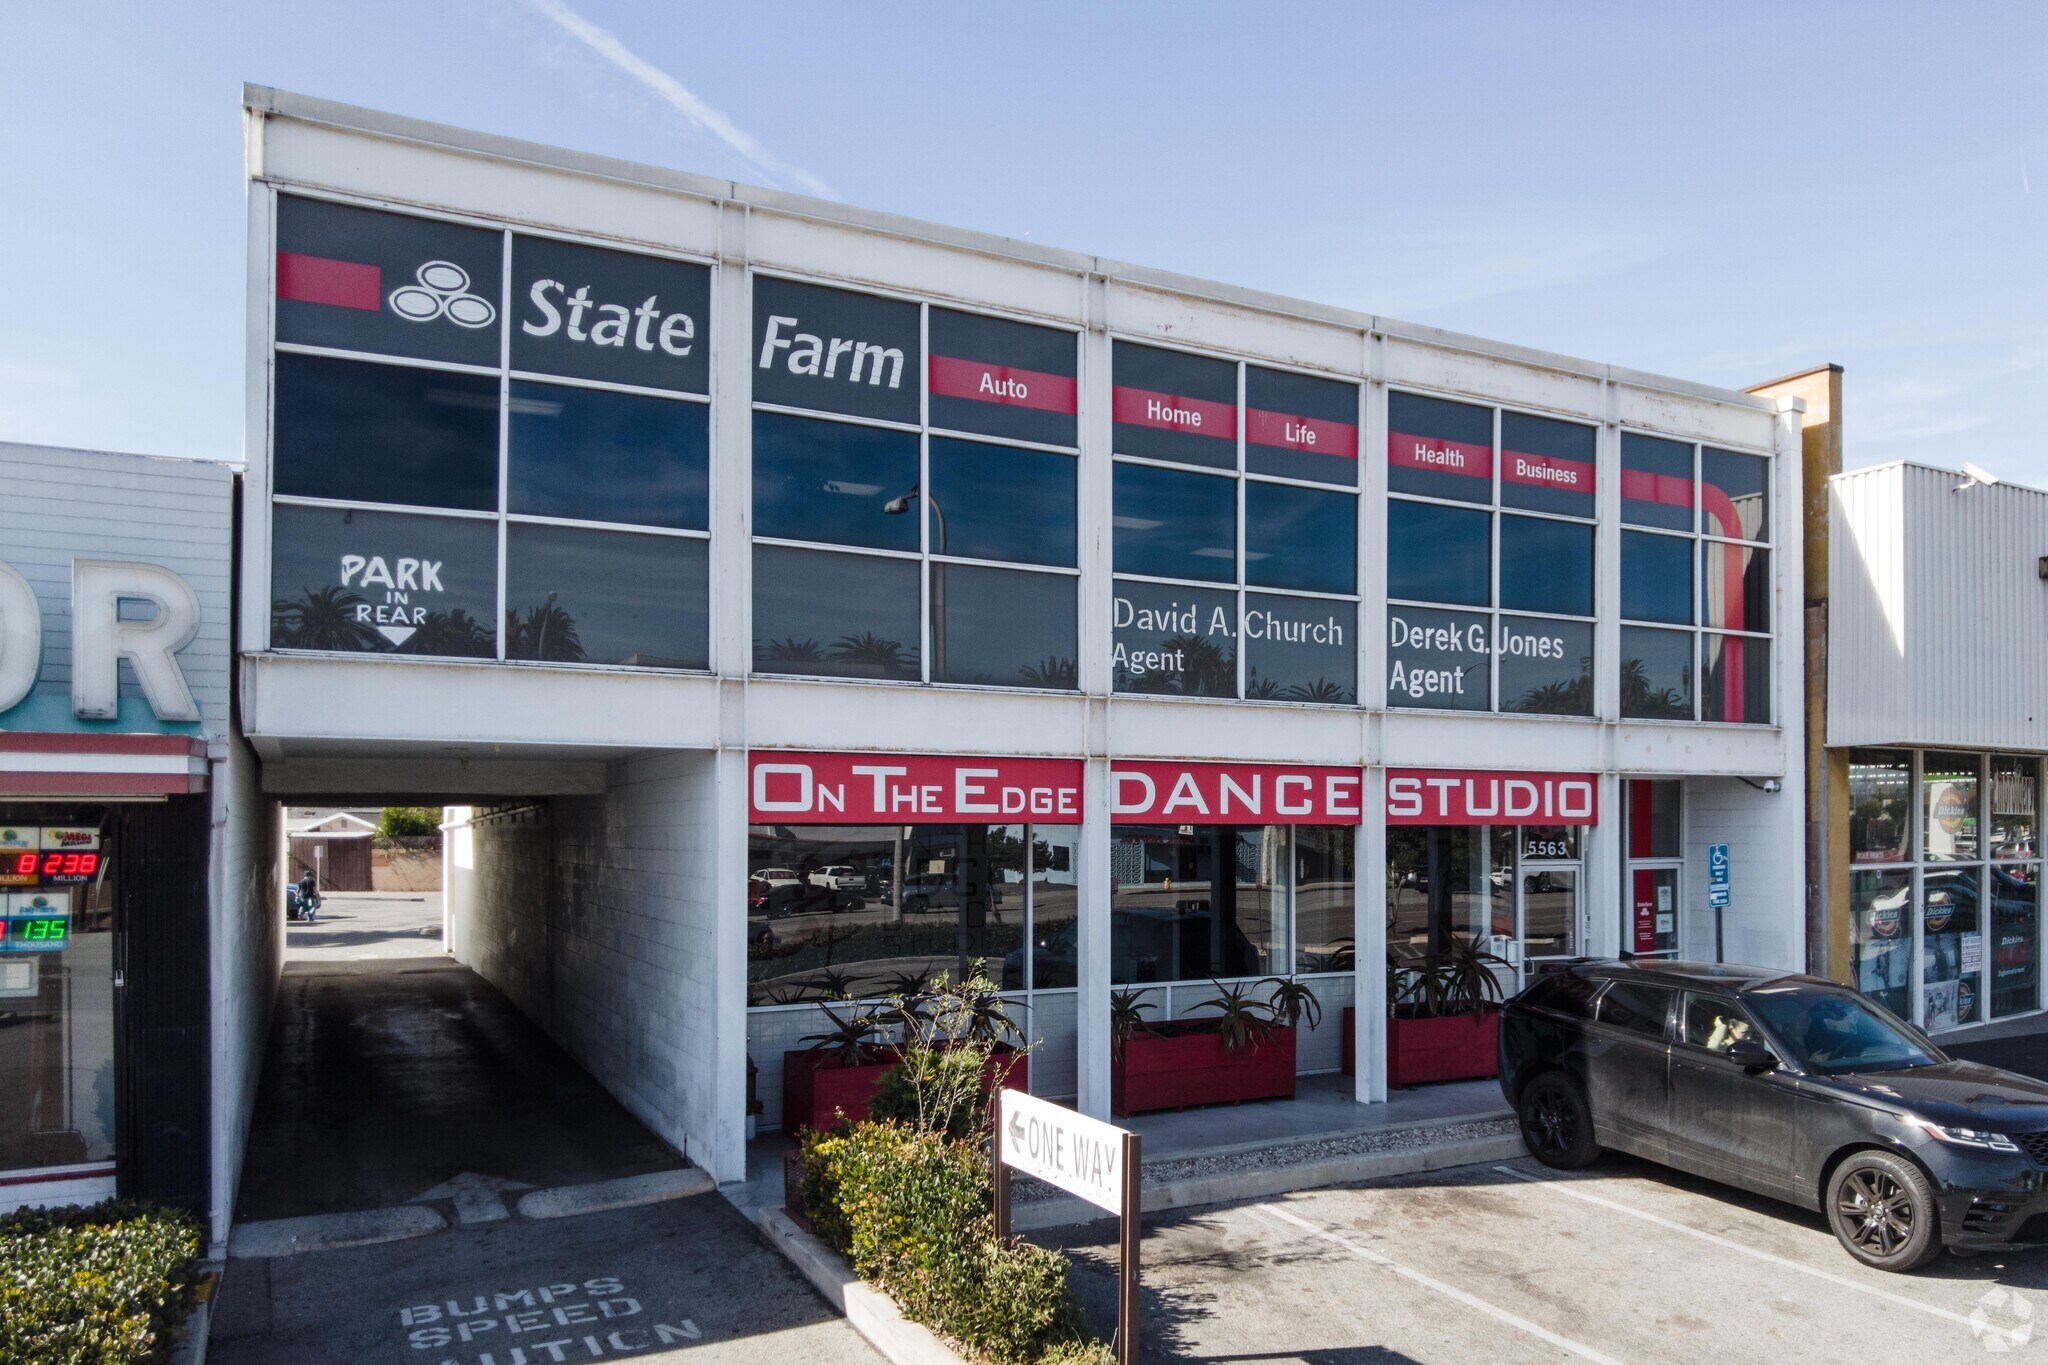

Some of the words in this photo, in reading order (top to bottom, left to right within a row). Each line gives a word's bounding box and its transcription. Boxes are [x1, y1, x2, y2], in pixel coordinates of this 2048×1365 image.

[523, 278, 694, 356] State
[759, 315, 904, 389] Farm
[979, 372, 1028, 399] Auto
[1147, 399, 1202, 427] Home
[1285, 422, 1317, 446] Life
[1414, 443, 1465, 468] Health
[1516, 459, 1578, 484] Business
[341, 554, 444, 592] PARK
[386, 591, 409, 605] IN
[356, 604, 427, 625] REAR
[1113, 597, 1197, 634] David
[1208, 606, 1237, 637] A.
[1245, 610, 1343, 646] Church
[1391, 617, 1463, 652] Derek
[1467, 624, 1490, 654] G.
[1498, 626, 1564, 659] Jones
[1112, 642, 1185, 675] Agent
[1389, 660, 1464, 698] Agent
[1110, 771, 1359, 815] DANCE
[1388, 777, 1592, 818] STUDIO
[1938, 805, 1965, 816] Dickies
[62, 831, 92, 841] MEGA
[1528, 841, 1566, 856] 5563
[18, 854, 37, 873] 8
[44, 854, 98, 874] 238
[1926, 907, 1952, 917] Dickies
[24, 920, 65, 939] 135
[1028, 1116, 1065, 1172] ONE
[1073, 1132, 1116, 1188] WAY
[400, 1277, 625, 1326] BUMPS
[409, 1298, 643, 1349] SPEED
